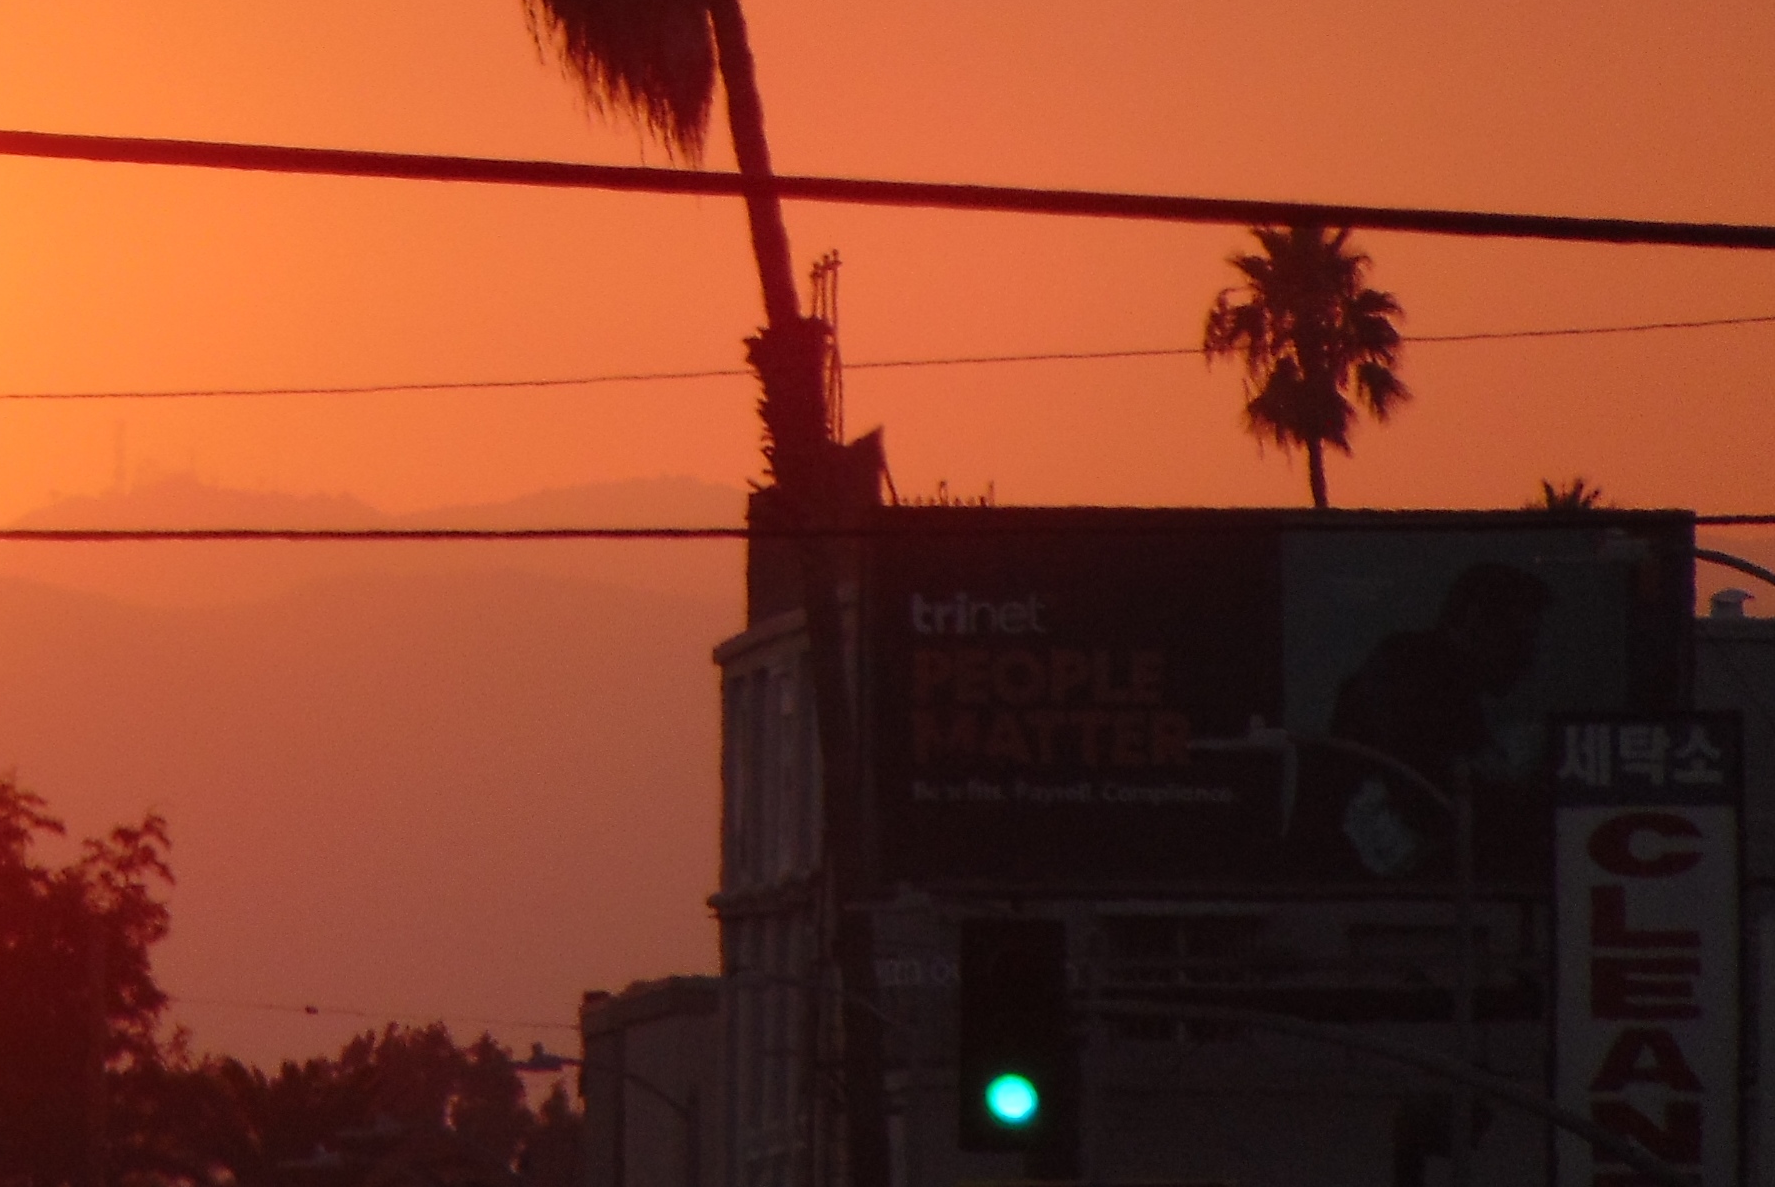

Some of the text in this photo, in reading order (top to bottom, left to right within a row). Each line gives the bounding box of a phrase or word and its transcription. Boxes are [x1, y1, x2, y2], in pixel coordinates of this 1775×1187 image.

[911, 591, 1047, 634] trinet
[912, 648, 1165, 705] PEOPLE
[912, 711, 1192, 766] MATTER
[1557, 723, 1724, 787] 세탁소
[1587, 812, 1704, 1187] CLEAN
